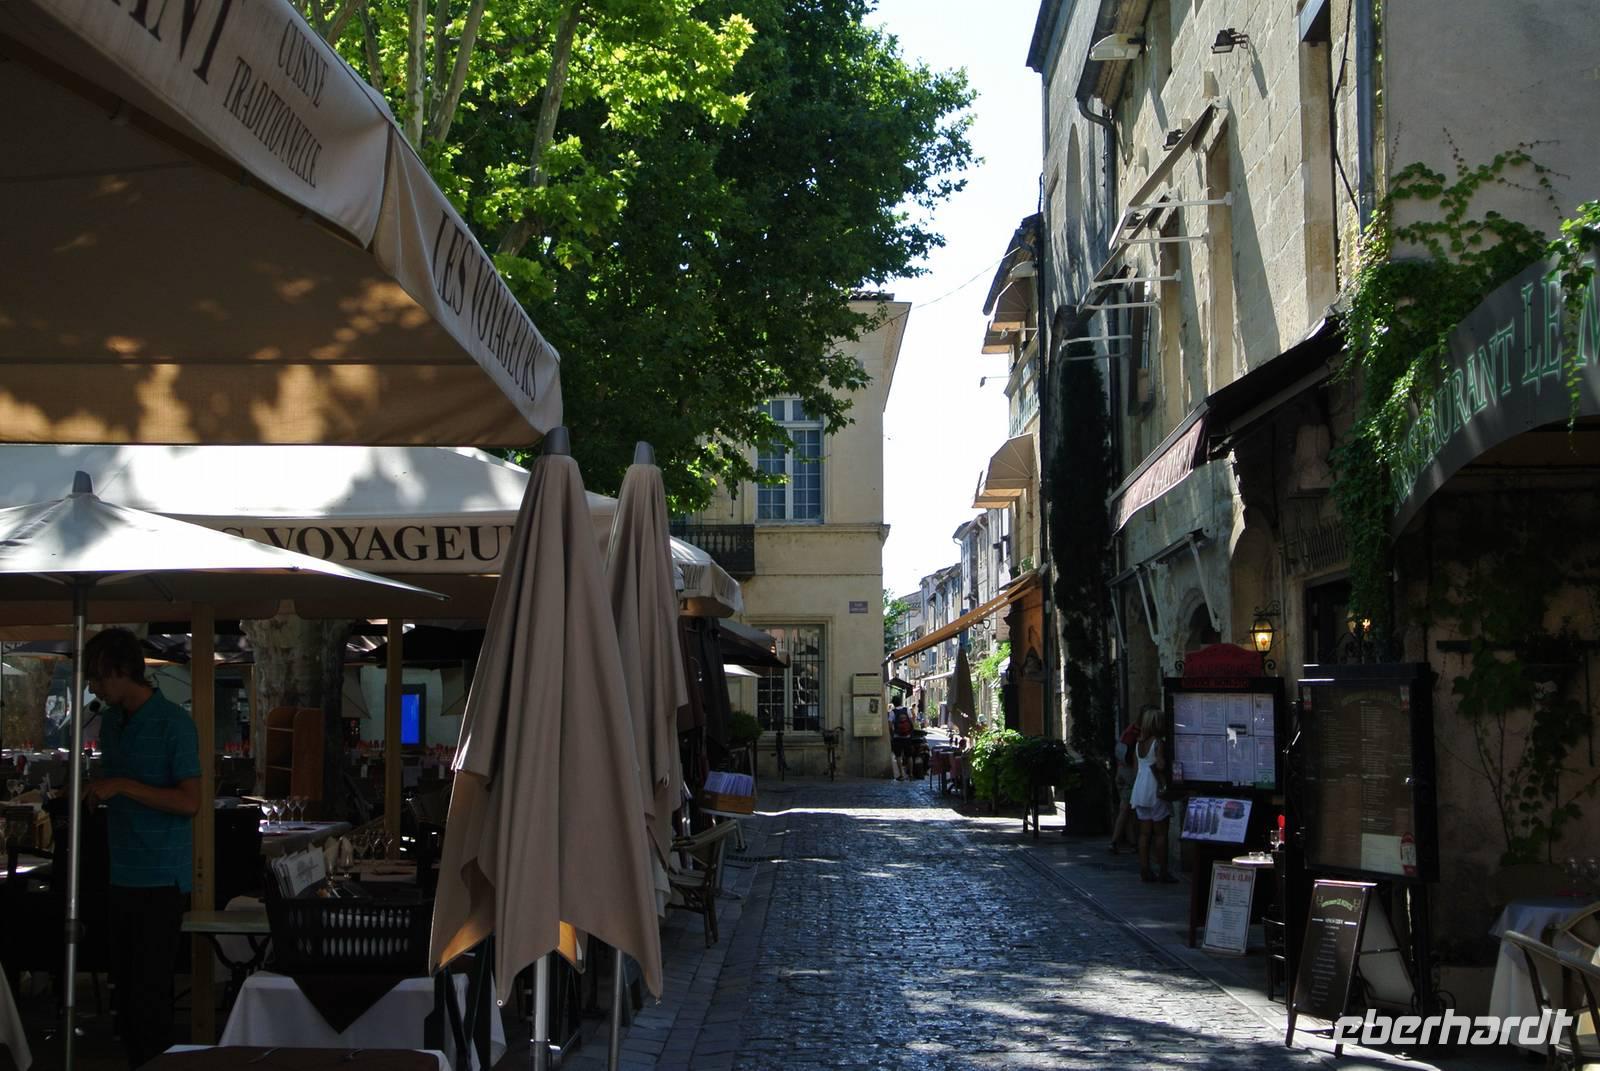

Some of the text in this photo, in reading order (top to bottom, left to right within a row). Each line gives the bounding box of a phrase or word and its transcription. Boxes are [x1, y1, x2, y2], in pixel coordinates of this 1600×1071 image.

[111, 0, 245, 85] NT
[278, 19, 329, 108] CUISINE
[223, 56, 323, 189] TRADITIONNELLE
[433, 210, 542, 401] LES VOYAGEURS
[1392, 316, 1515, 517] ESTAURANT
[1521, 270, 1563, 395] LE
[259, 524, 514, 562] VOYAGEU
